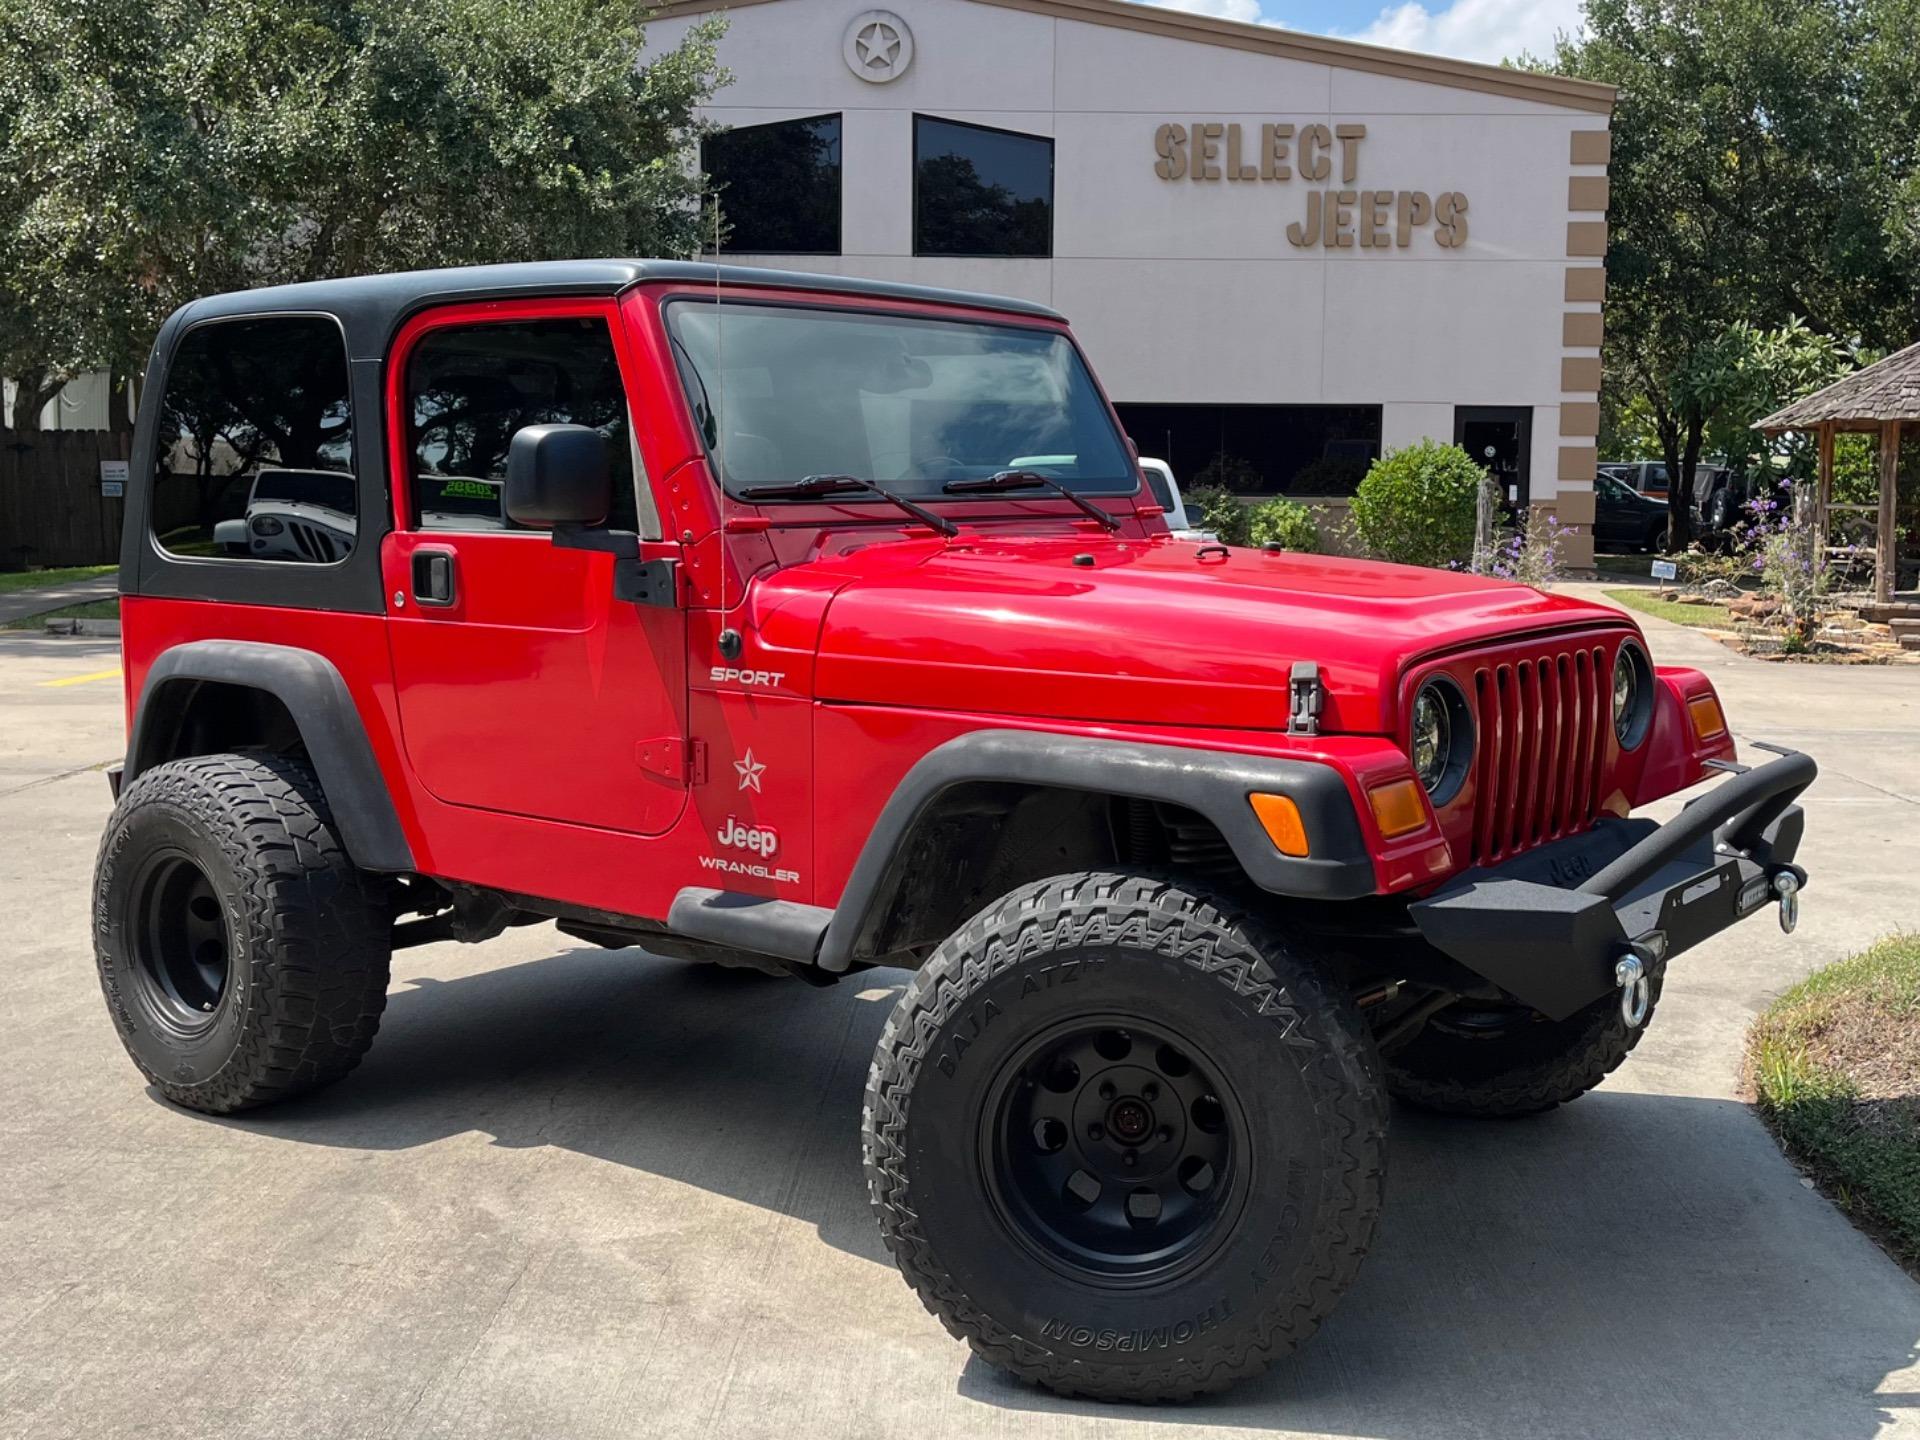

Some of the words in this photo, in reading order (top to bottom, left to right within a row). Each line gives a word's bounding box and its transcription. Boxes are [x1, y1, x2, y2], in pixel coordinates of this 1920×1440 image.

[1154, 123, 1366, 183] SELECT
[1286, 191, 1469, 248] JEEPS
[709, 666, 785, 688] SPORT
[717, 818, 777, 858] Jeep
[698, 856, 800, 884] WRANGLER
[936, 998, 1002, 1079] BAJA
[1040, 1301, 1239, 1353] THOMPSON
